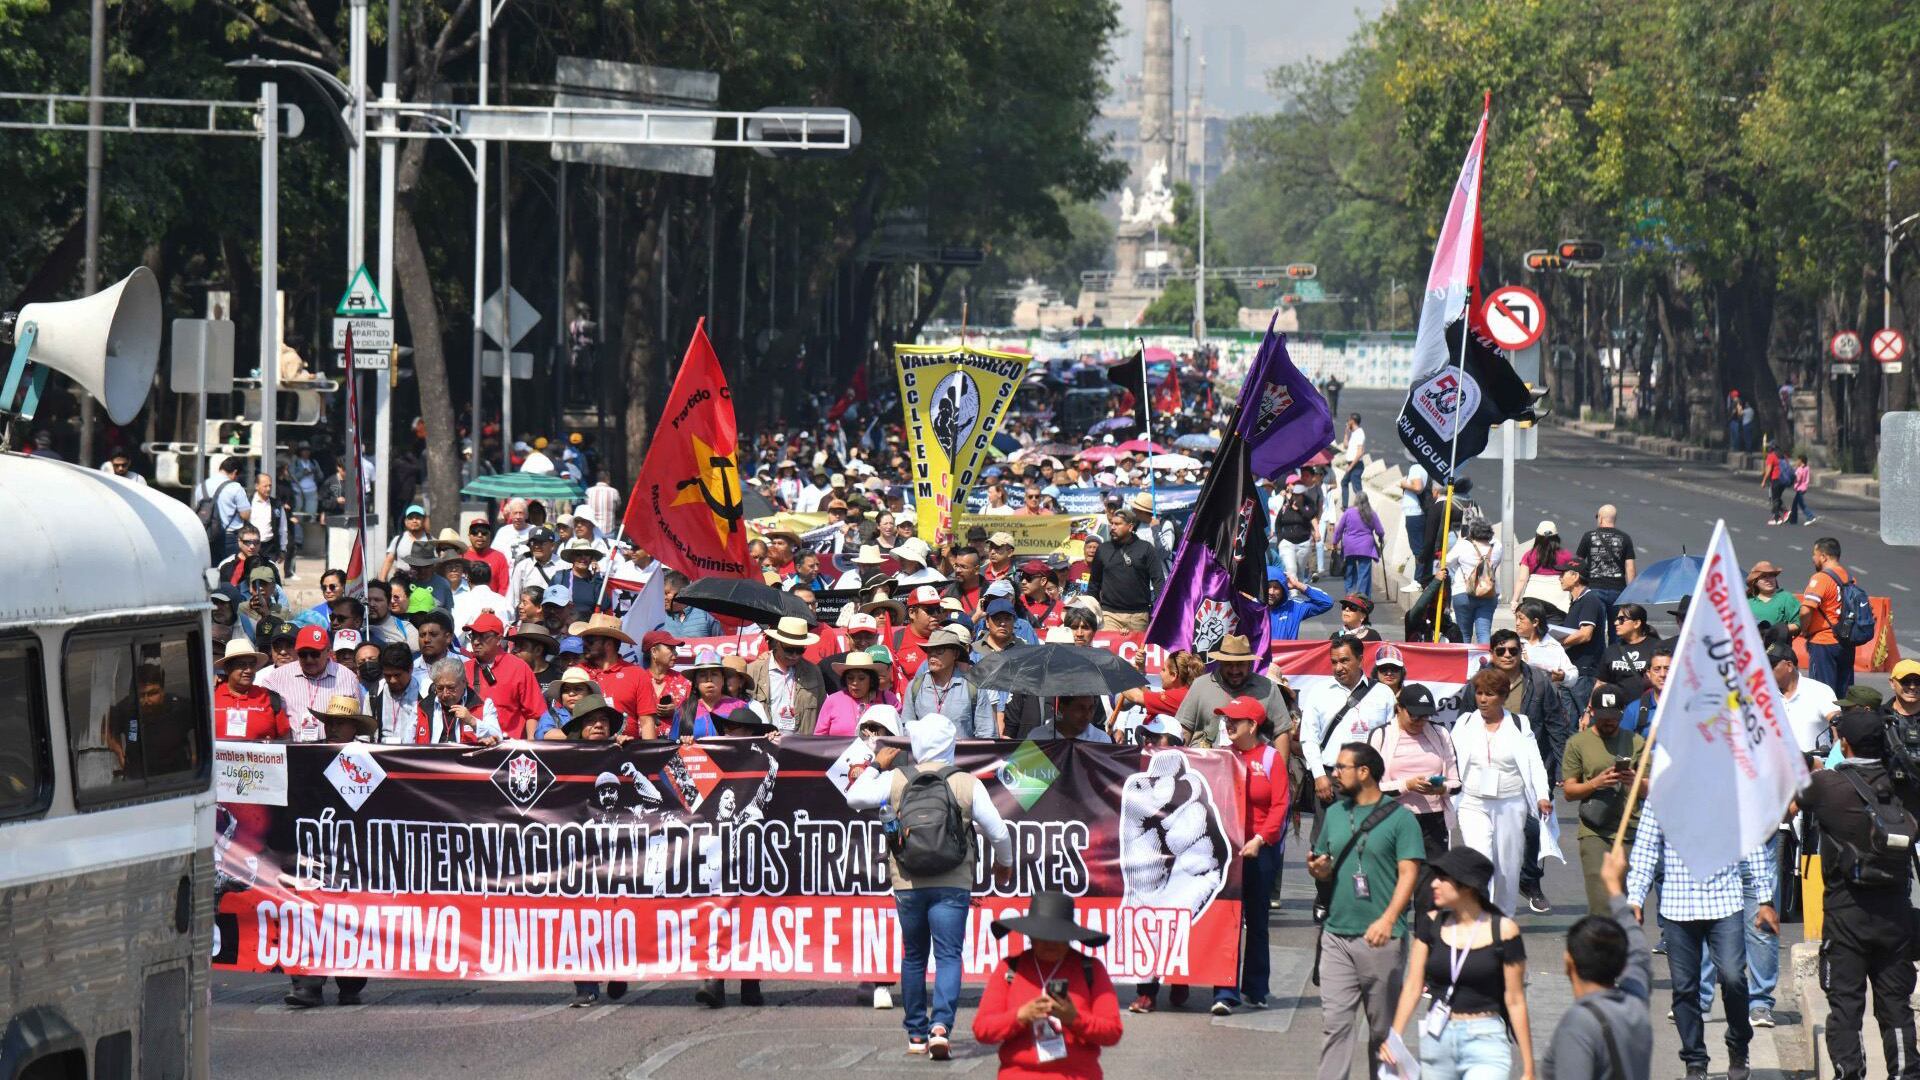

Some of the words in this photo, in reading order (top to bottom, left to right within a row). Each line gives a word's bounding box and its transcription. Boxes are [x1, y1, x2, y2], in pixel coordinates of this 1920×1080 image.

[350, 320, 377, 328] CARRIL
[338, 329, 390, 338] CMPARTIDO
[354, 357, 387, 366] NICIA
[899, 354, 946, 370] VALLE
[672, 388, 711, 429] Partido
[1420, 393, 1447, 427] situam
[246, 751, 284, 764] Nacional
[226, 765, 265, 780] Usuarios
[296, 807, 365, 892] DÍA
[366, 819, 653, 901] INTERNACIONAL
[661, 821, 712, 899] DE
[719, 820, 789, 897] LOS
[796, 819, 1090, 899] TRABDORES
[256, 900, 469, 976] COMBATIVO,
[480, 907, 646, 978] UNITARIO,
[656, 909, 698, 976] DE
[708, 905, 815, 975] CLASE
[820, 908, 842, 974] E
[852, 905, 1192, 978] INTNAALISTA
